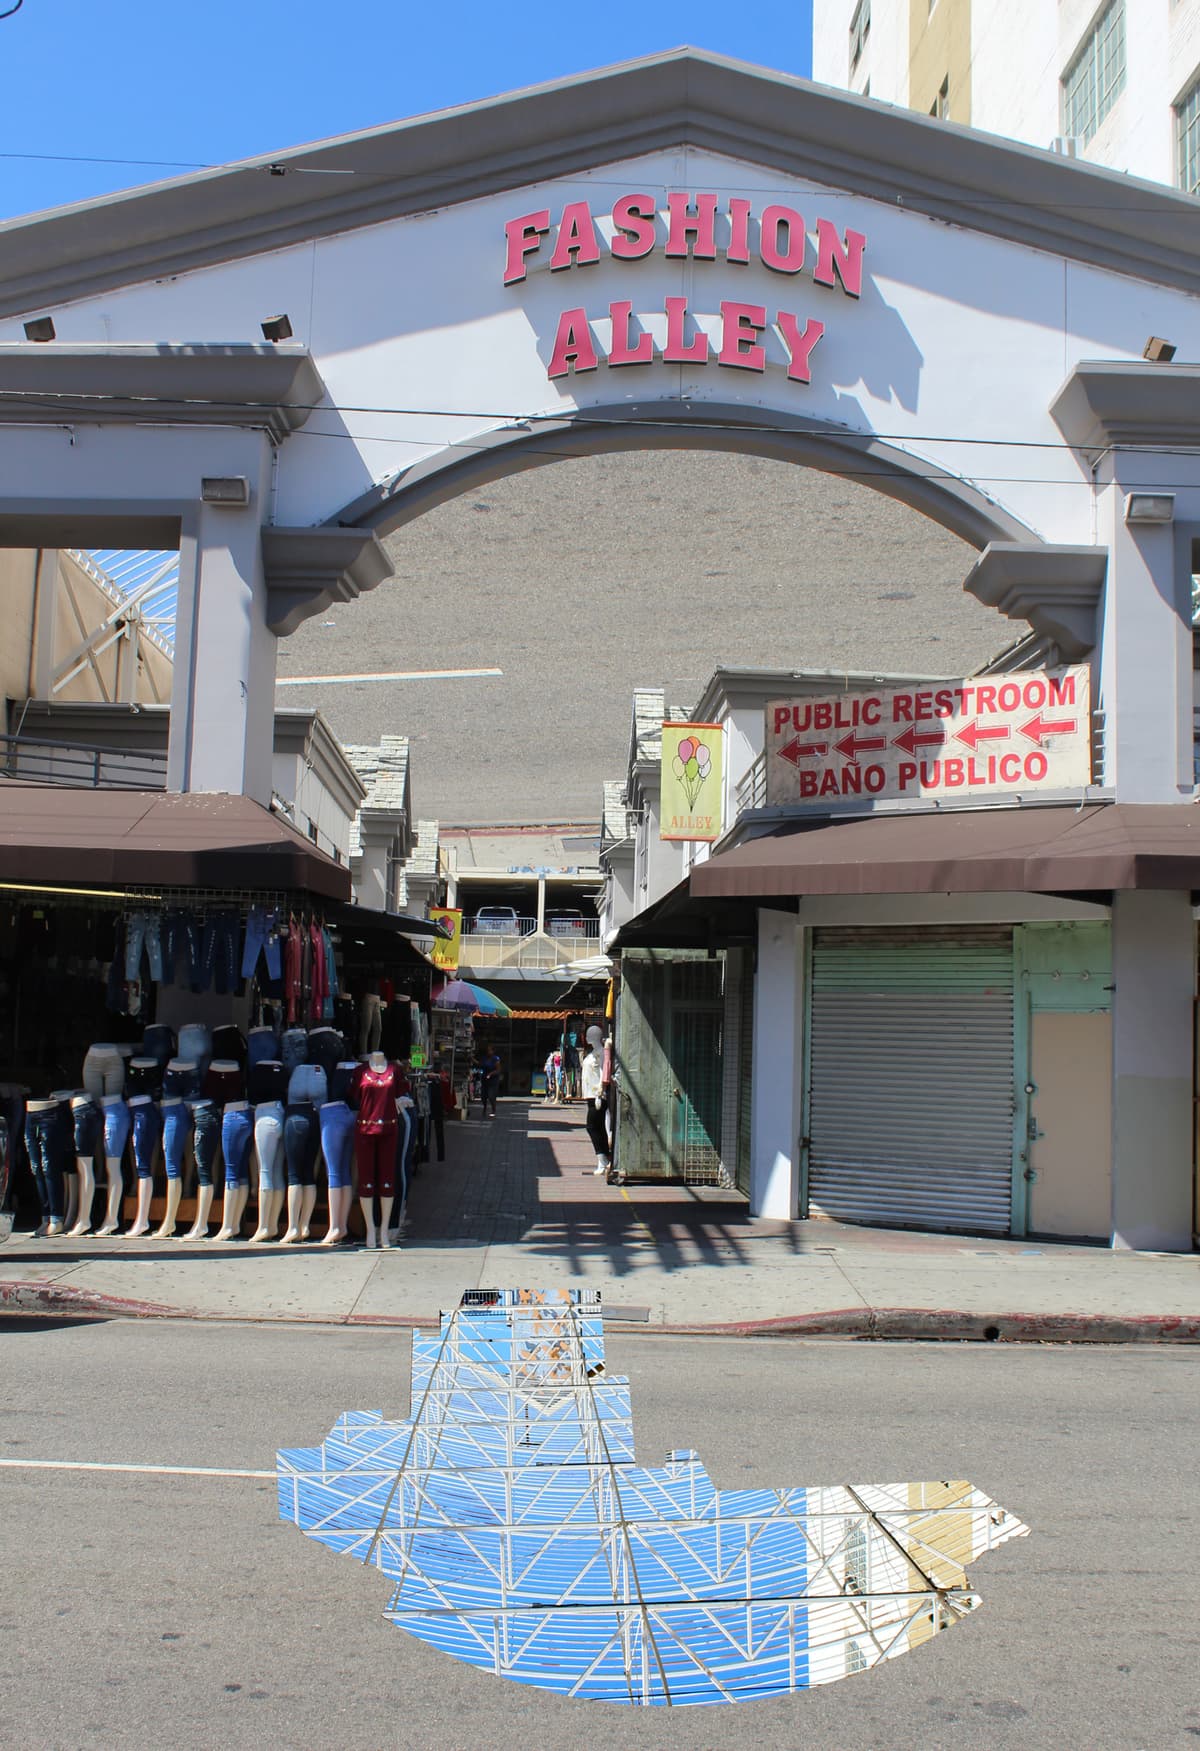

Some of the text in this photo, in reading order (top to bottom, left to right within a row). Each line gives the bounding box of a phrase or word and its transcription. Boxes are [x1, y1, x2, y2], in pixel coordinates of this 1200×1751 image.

[503, 193, 867, 299] FASHION
[548, 296, 825, 385] ALLEY
[774, 675, 1077, 735] PUBLIC RESTROOM
[799, 752, 1049, 797] BAÑO PUBLICO
[671, 815, 713, 830] ALLEY
